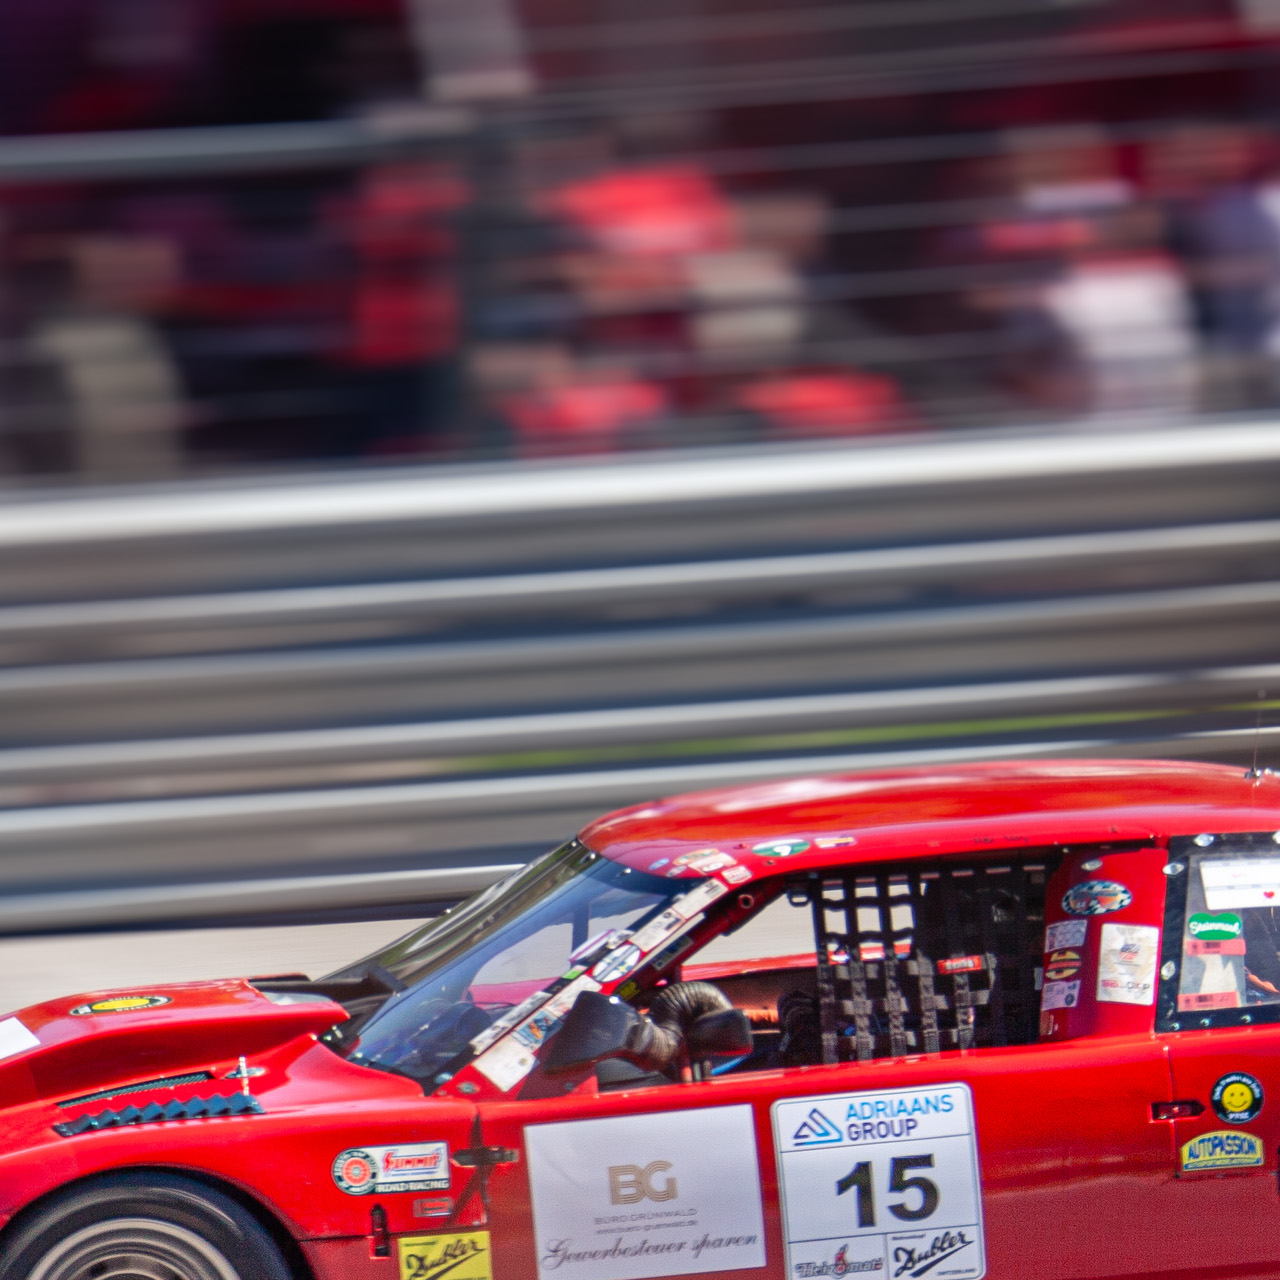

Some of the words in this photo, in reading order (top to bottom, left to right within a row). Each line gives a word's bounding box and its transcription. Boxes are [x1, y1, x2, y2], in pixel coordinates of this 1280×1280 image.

[845, 1094, 954, 1122] ADRIAANS
[847, 1118, 919, 1141] GROUP
[607, 1160, 679, 1205] BG
[835, 1153, 941, 1229] 15
[540, 1231, 689, 1270] Gewerbesteuer
[691, 1231, 758, 1259] sparen
